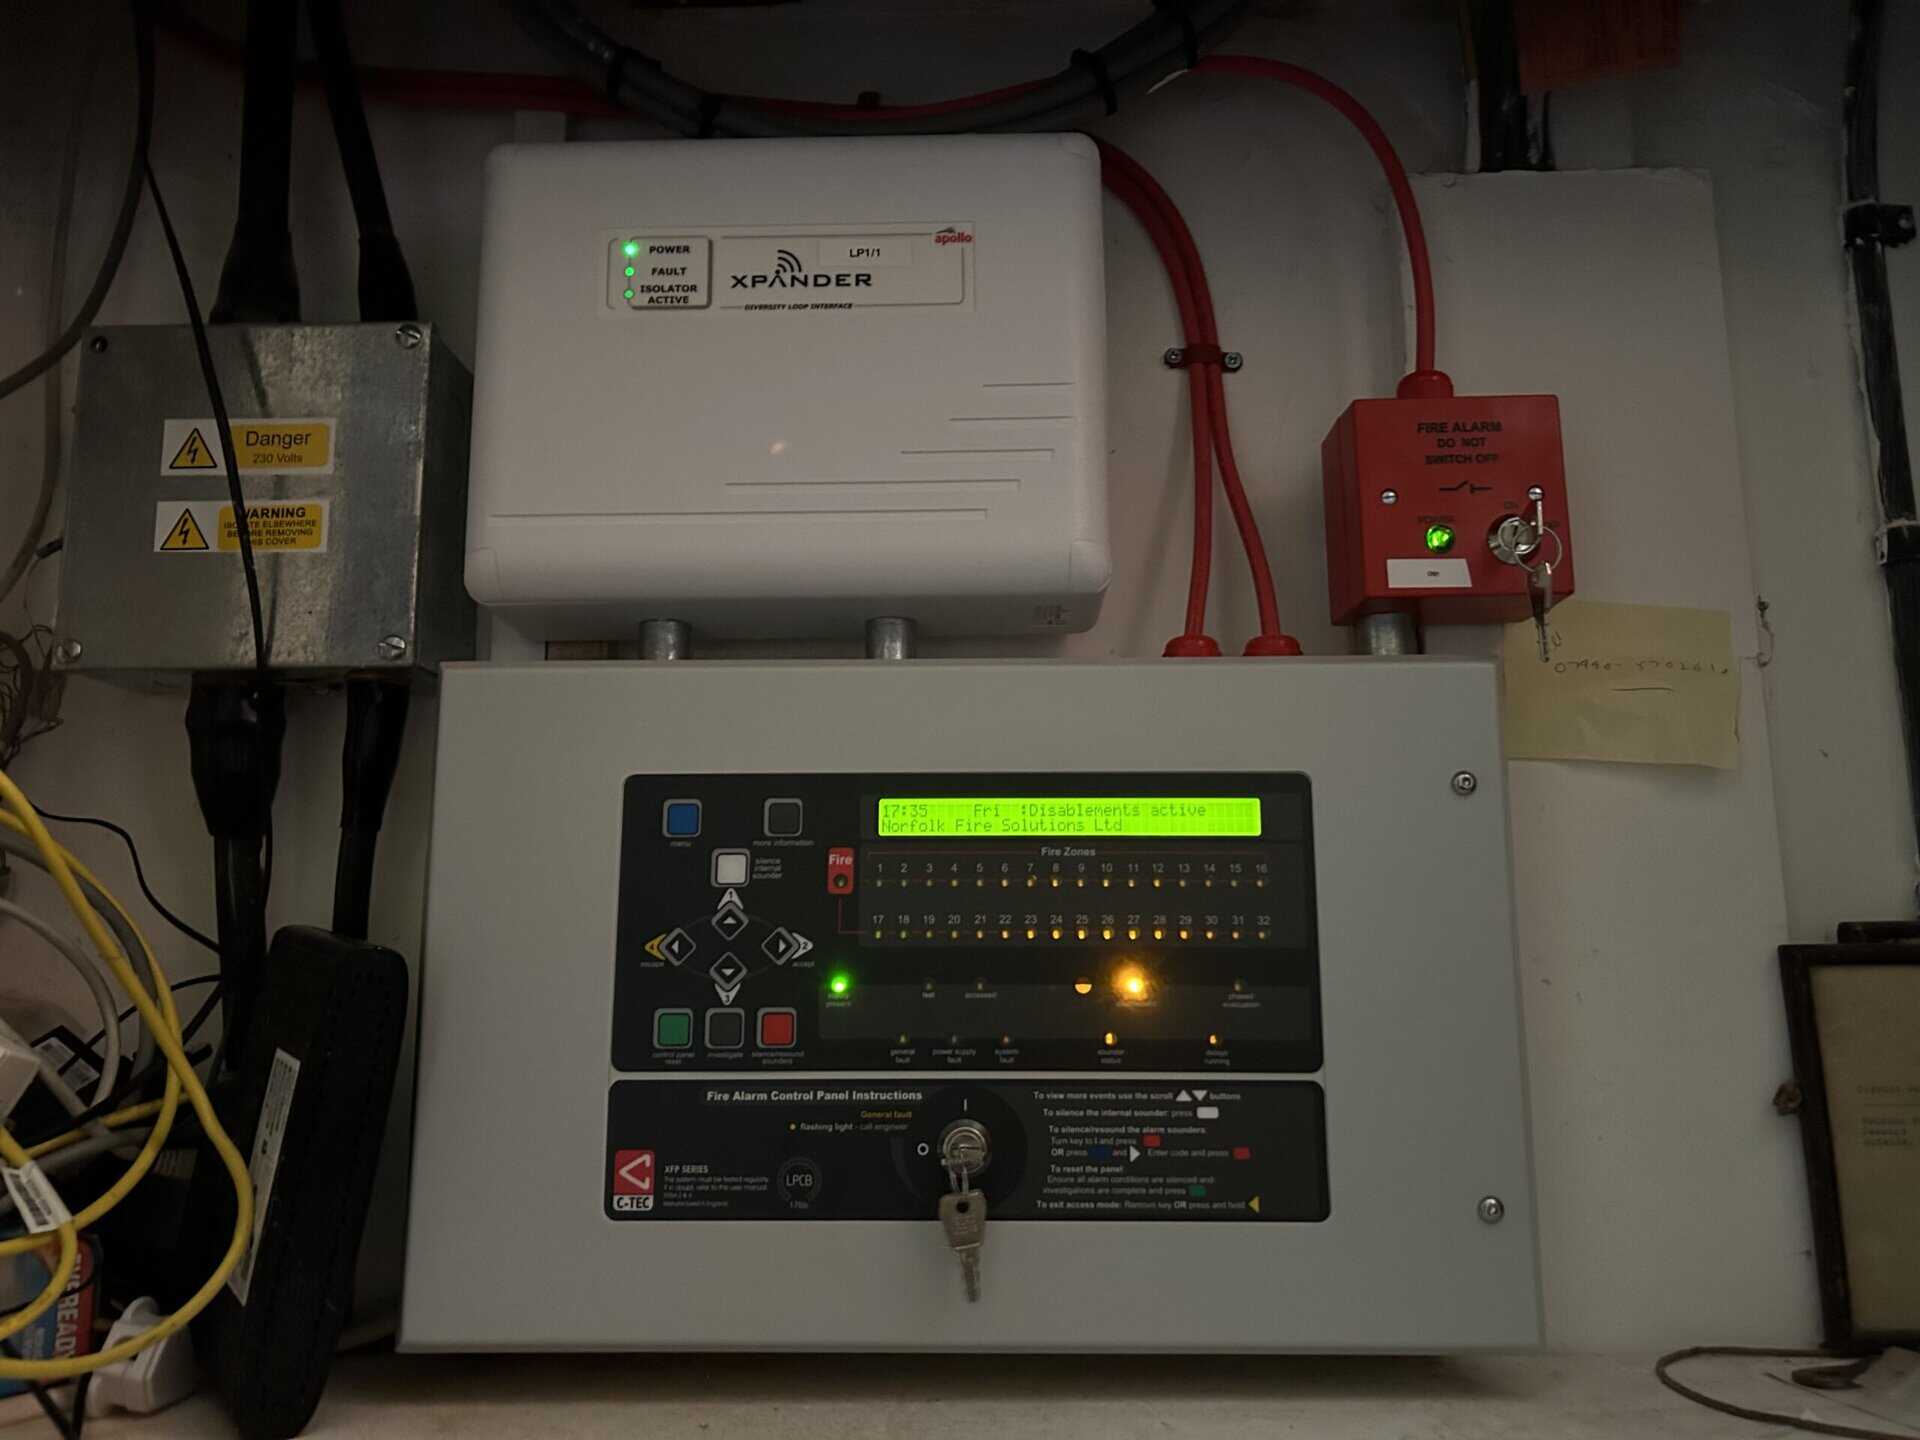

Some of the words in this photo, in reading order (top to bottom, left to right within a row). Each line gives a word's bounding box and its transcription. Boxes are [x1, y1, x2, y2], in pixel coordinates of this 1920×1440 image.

[935, 231, 972, 245] apollo
[649, 245, 690, 254] POWER
[849, 248, 881, 258] LP1/1
[652, 267, 687, 276] FAULT
[731, 270, 873, 289] XPANDER
[641, 284, 698, 294] ISOLATOR
[648, 295, 689, 305] ACTIVE
[1417, 422, 1448, 434] FIRE
[1452, 421, 1502, 433] ALARM
[246, 431, 311, 449] Danger
[1437, 438, 1455, 448] DO
[1462, 437, 1486, 447] NOT
[253, 455, 273, 464] 230
[276, 453, 303, 464] Volts
[265, 528, 313, 537] REMOVING
[266, 537, 297, 545] COVER
[882, 804, 928, 817] 17:35
[973, 804, 1000, 817] Fri
[1150, 804, 1207, 817] active
[881, 819, 945, 833] Norfolk
[955, 819, 993, 833] Fire
[1001, 819, 1085, 833] Solutions
[1094, 818, 1123, 832] Ltd
[1041, 846, 1061, 856] Fire
[1063, 847, 1096, 857] Zones
[828, 854, 853, 865] Fire
[878, 863, 882, 873] 1
[901, 863, 907, 873] 2
[926, 863, 933, 873] 3
[950, 863, 958, 873] 4
[976, 863, 983, 873] 5
[1001, 863, 1008, 873] 6
[1027, 863, 1034, 873] 7
[1078, 863, 1085, 873] 9
[1101, 863, 1112, 873] 10
[1128, 863, 1139, 873] 11
[1153, 863, 1165, 873] 12
[1179, 863, 1190, 873] 13
[1204, 863, 1215, 873] 14
[1230, 863, 1241, 873] 15
[1256, 863, 1268, 873] 16
[873, 915, 884, 924] 17
[898, 915, 910, 924] 18
[923, 915, 935, 924] 19
[948, 915, 961, 924] 20
[974, 915, 986, 924] 21
[999, 915, 1012, 924] 22
[1024, 915, 1037, 924] 23
[1050, 915, 1063, 924] 24
[1076, 915, 1088, 925] 25
[1101, 915, 1114, 925] 26
[1127, 915, 1140, 925] 27
[1153, 915, 1166, 925] 28
[1179, 915, 1192, 925] 29
[1205, 915, 1218, 925] 30
[1232, 915, 1244, 925] 31
[1257, 915, 1271, 925] 32
[706, 1091, 730, 1101] Fire
[732, 1091, 767, 1101] Alarm
[770, 1091, 813, 1101] Control
[817, 1091, 849, 1100] Panel
[852, 1090, 922, 1100] Instructions
[1033, 1091, 1045, 1099] To
[860, 1110, 892, 1119] General
[893, 1110, 912, 1119] fault
[1043, 1108, 1053, 1116] To
[800, 1123, 833, 1132] flashing
[834, 1122, 852, 1132] light
[1049, 1125, 1059, 1133] To
[1069, 1137, 1083, 1146] key
[1051, 1148, 1064, 1156] OR
[664, 1165, 680, 1173] XFP
[682, 1165, 709, 1173] SERIES
[1050, 1164, 1061, 1173] To
[616, 1196, 650, 1209] C-TEC
[1036, 1201, 1047, 1209] To
[1066, 1201, 1094, 1209] access
[1174, 1201, 1188, 1209] OR
